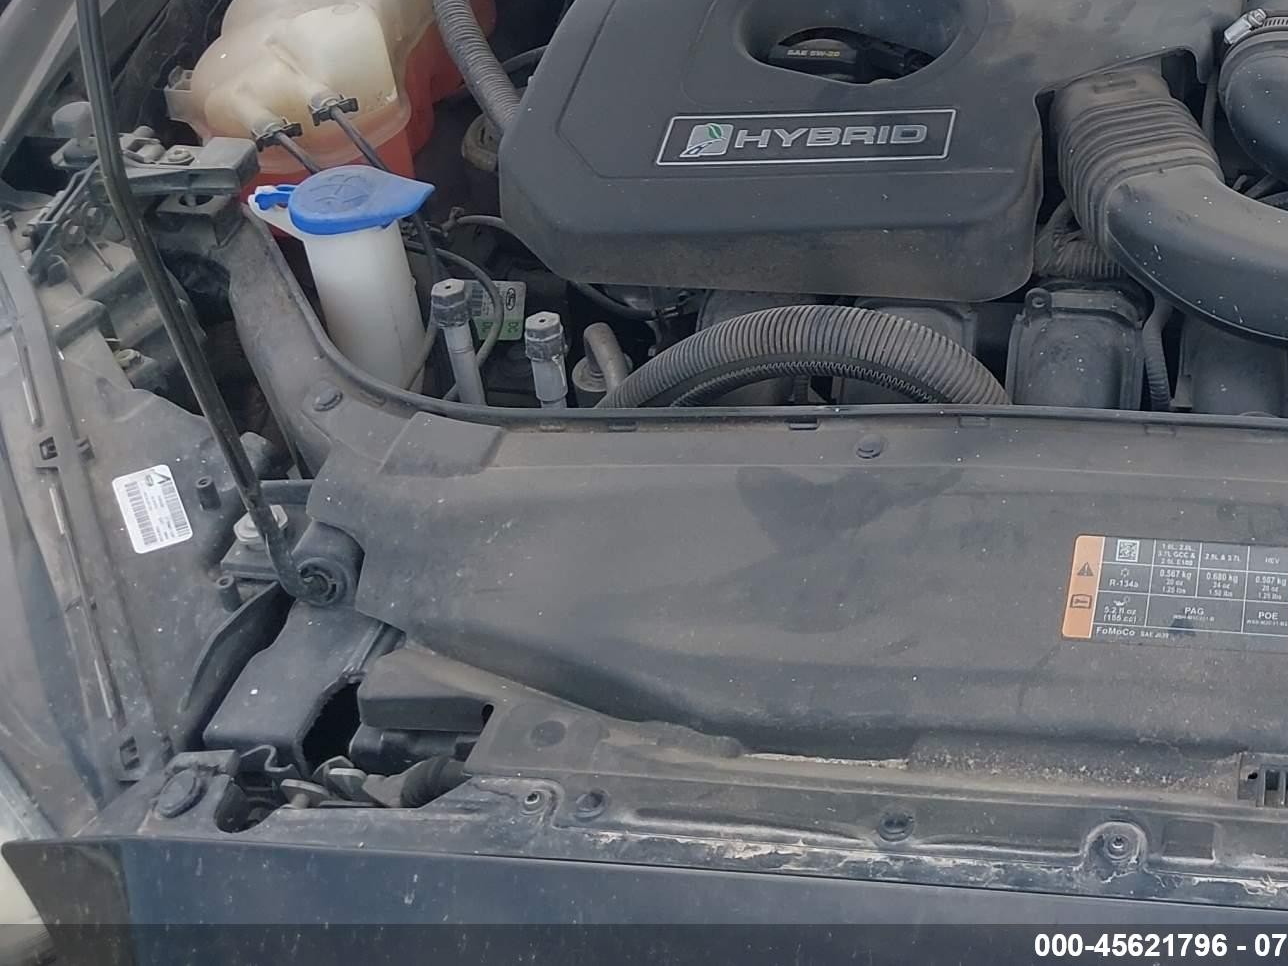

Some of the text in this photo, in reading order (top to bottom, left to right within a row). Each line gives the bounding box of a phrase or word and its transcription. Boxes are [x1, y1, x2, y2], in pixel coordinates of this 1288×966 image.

[735, 124, 928, 148] HYBRID
[1181, 570, 1192, 580] kg
[1228, 574, 1238, 584] kg
[1109, 579, 1139, 587] R-134a
[1277, 577, 1287, 587] kg
[1104, 606, 1116, 614] 5.2
[1184, 607, 1205, 615] PAG
[1258, 611, 1279, 620] POE
[1096, 627, 1136, 636] FoMoCo
